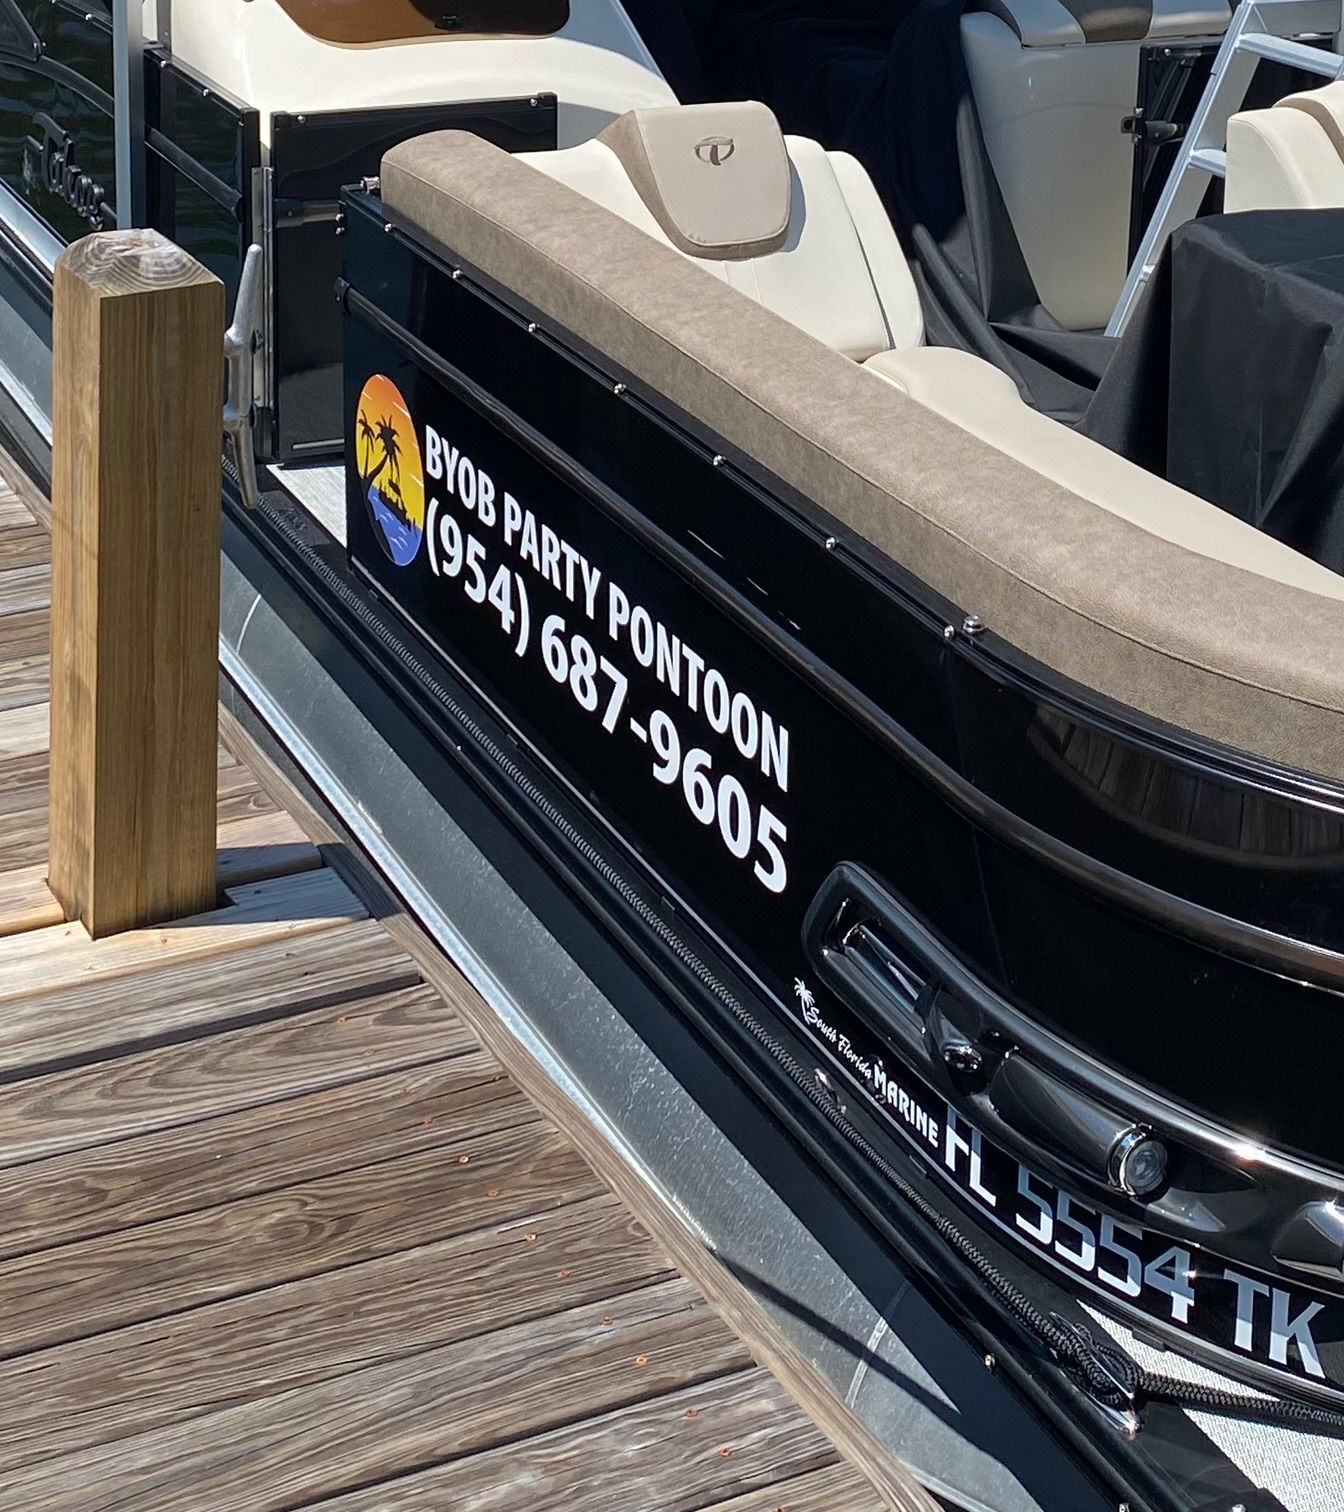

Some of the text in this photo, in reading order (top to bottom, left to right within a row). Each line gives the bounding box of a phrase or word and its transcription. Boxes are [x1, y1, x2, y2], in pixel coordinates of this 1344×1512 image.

[425, 424, 790, 793] BYOB PARTY PONTOON
[426, 497, 788, 894] (954) 687-9605
[806, 1005, 939, 1149] South Florida MARINE
[944, 1105, 1326, 1379] FL 5554 TK
